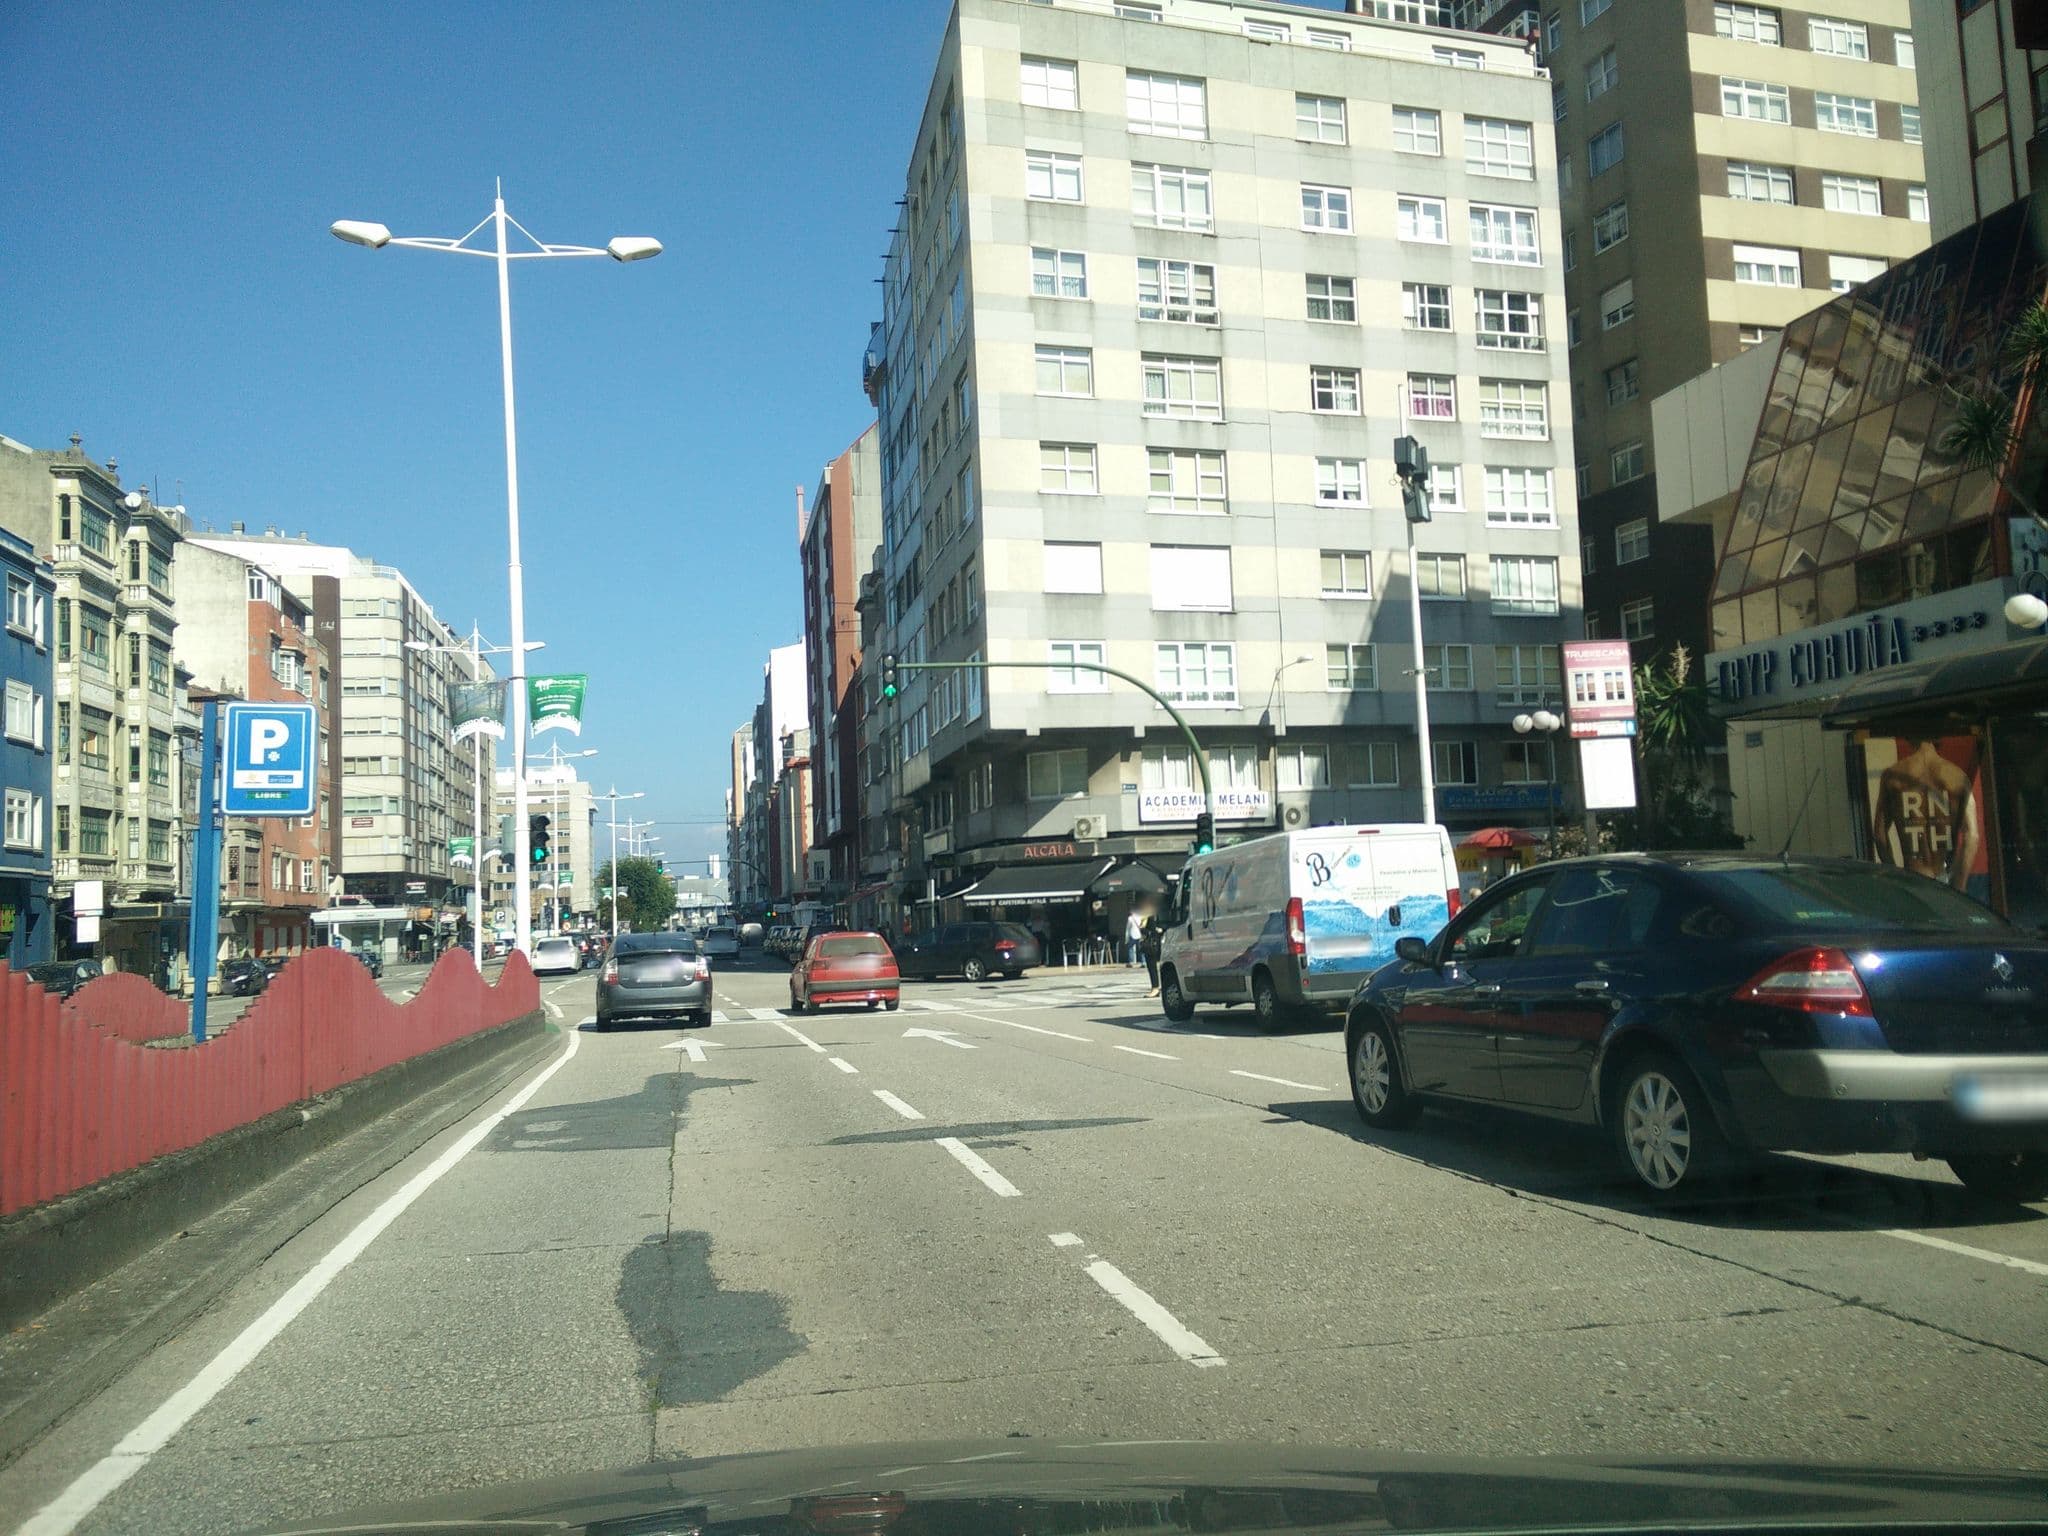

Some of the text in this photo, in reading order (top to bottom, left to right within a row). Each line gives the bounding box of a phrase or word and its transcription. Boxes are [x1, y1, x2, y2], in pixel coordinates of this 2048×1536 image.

[1789, 615, 1903, 689] CORUÑA
[250, 718, 290, 765] P
[1144, 793, 1267, 808] ACADEMI MELANI
[1902, 789, 1950, 818] RN
[1904, 825, 1953, 852] TH
